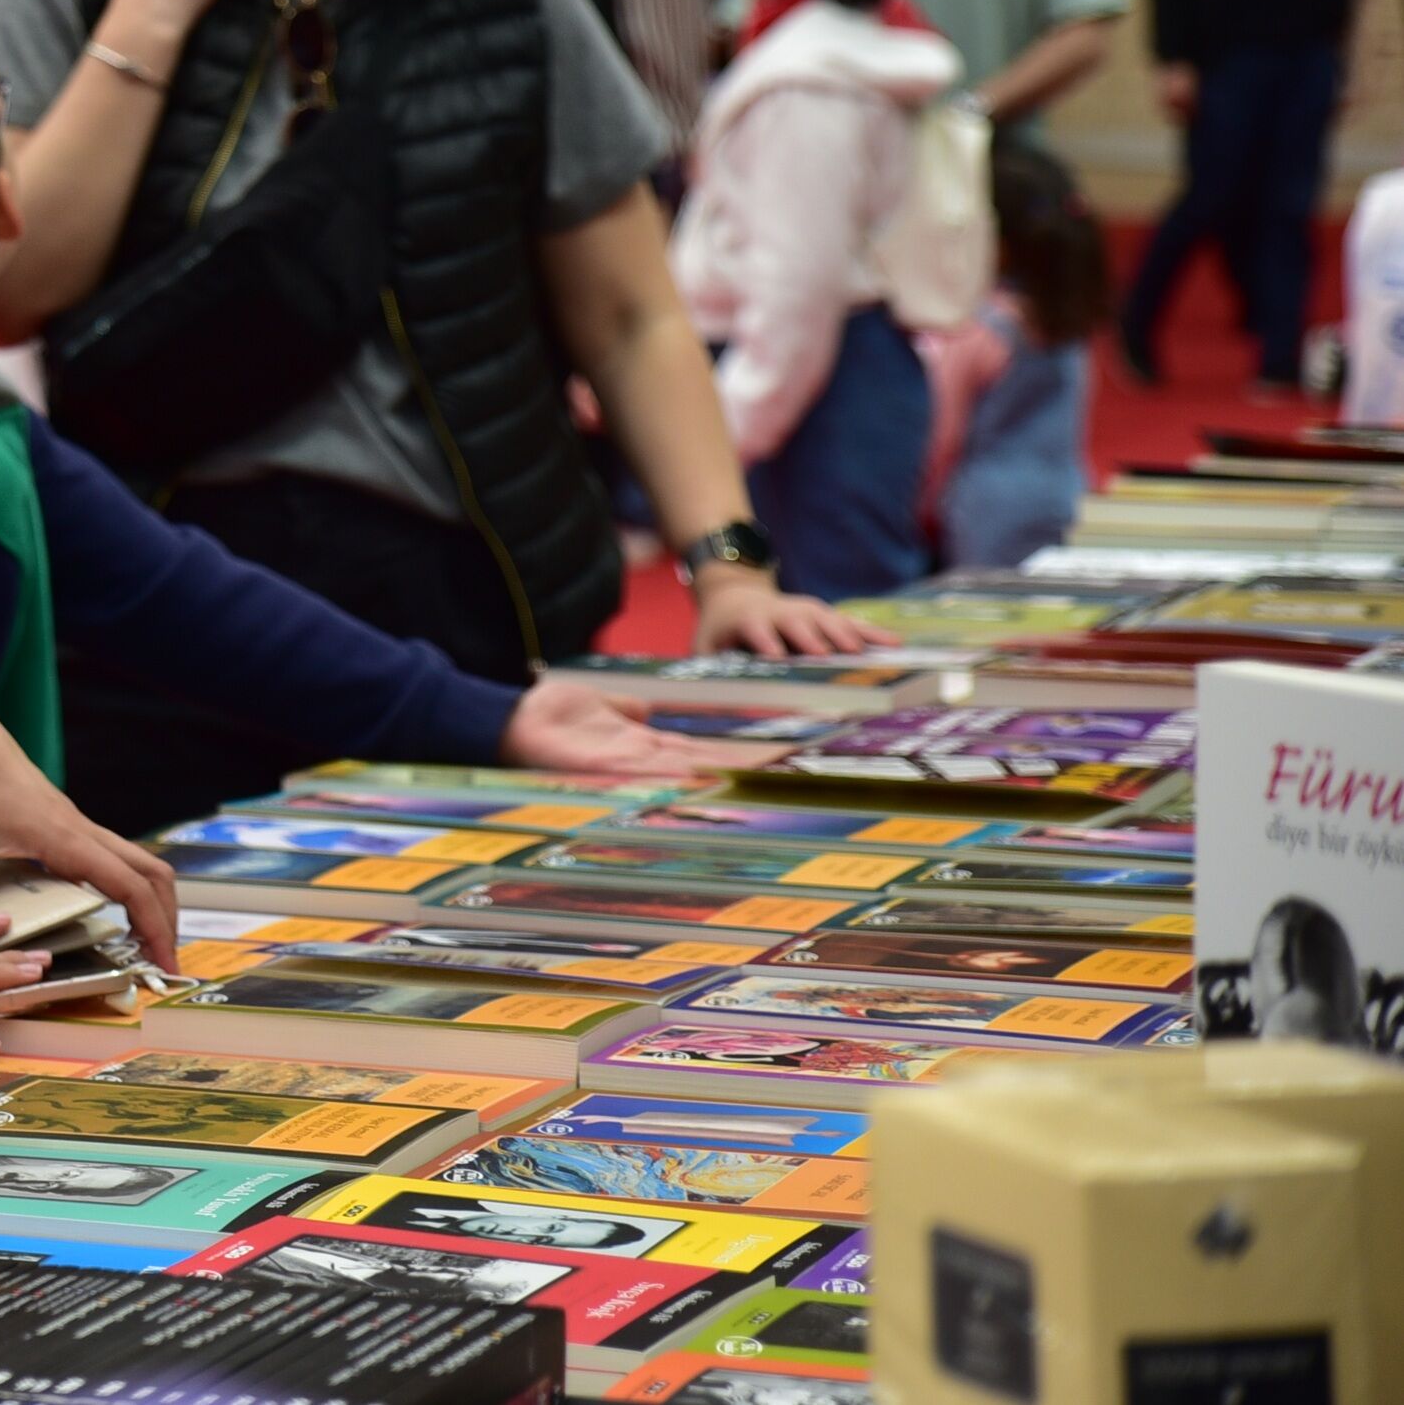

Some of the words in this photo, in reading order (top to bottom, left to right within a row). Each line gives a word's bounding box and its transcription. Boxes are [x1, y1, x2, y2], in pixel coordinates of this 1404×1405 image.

[1265, 813, 1311, 858] diye
[1318, 822, 1349, 856] bir
[193, 1194, 242, 1218] Yusuf
[265, 1197, 287, 1209] Ali
[585, 1294, 635, 1320] Köşk
[650, 1309, 674, 1324] Ali
